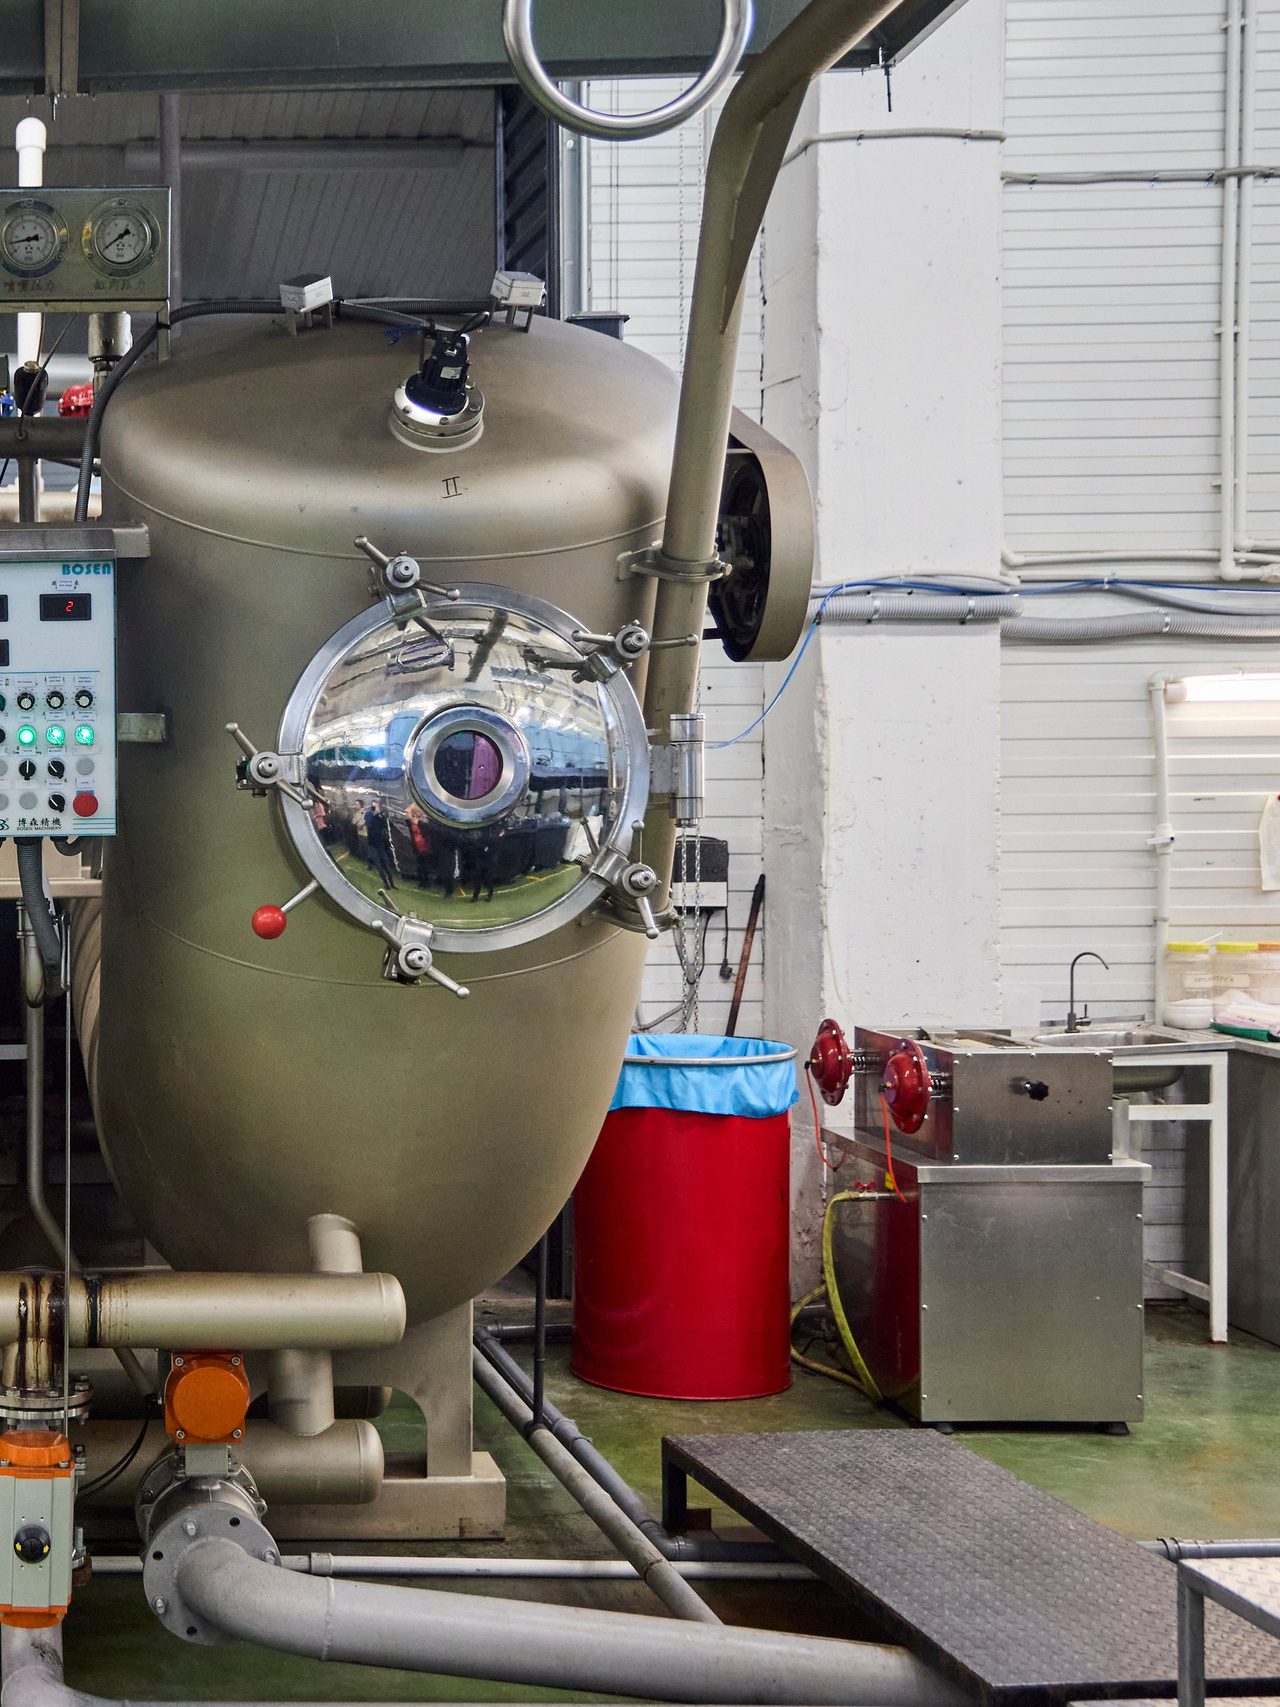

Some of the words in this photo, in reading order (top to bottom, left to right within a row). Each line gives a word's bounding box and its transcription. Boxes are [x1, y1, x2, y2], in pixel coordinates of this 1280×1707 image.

[61, 563, 112, 576] BOSEN
[65, 600, 74, 613] 2
[17, 817, 62, 827] 博森精機
